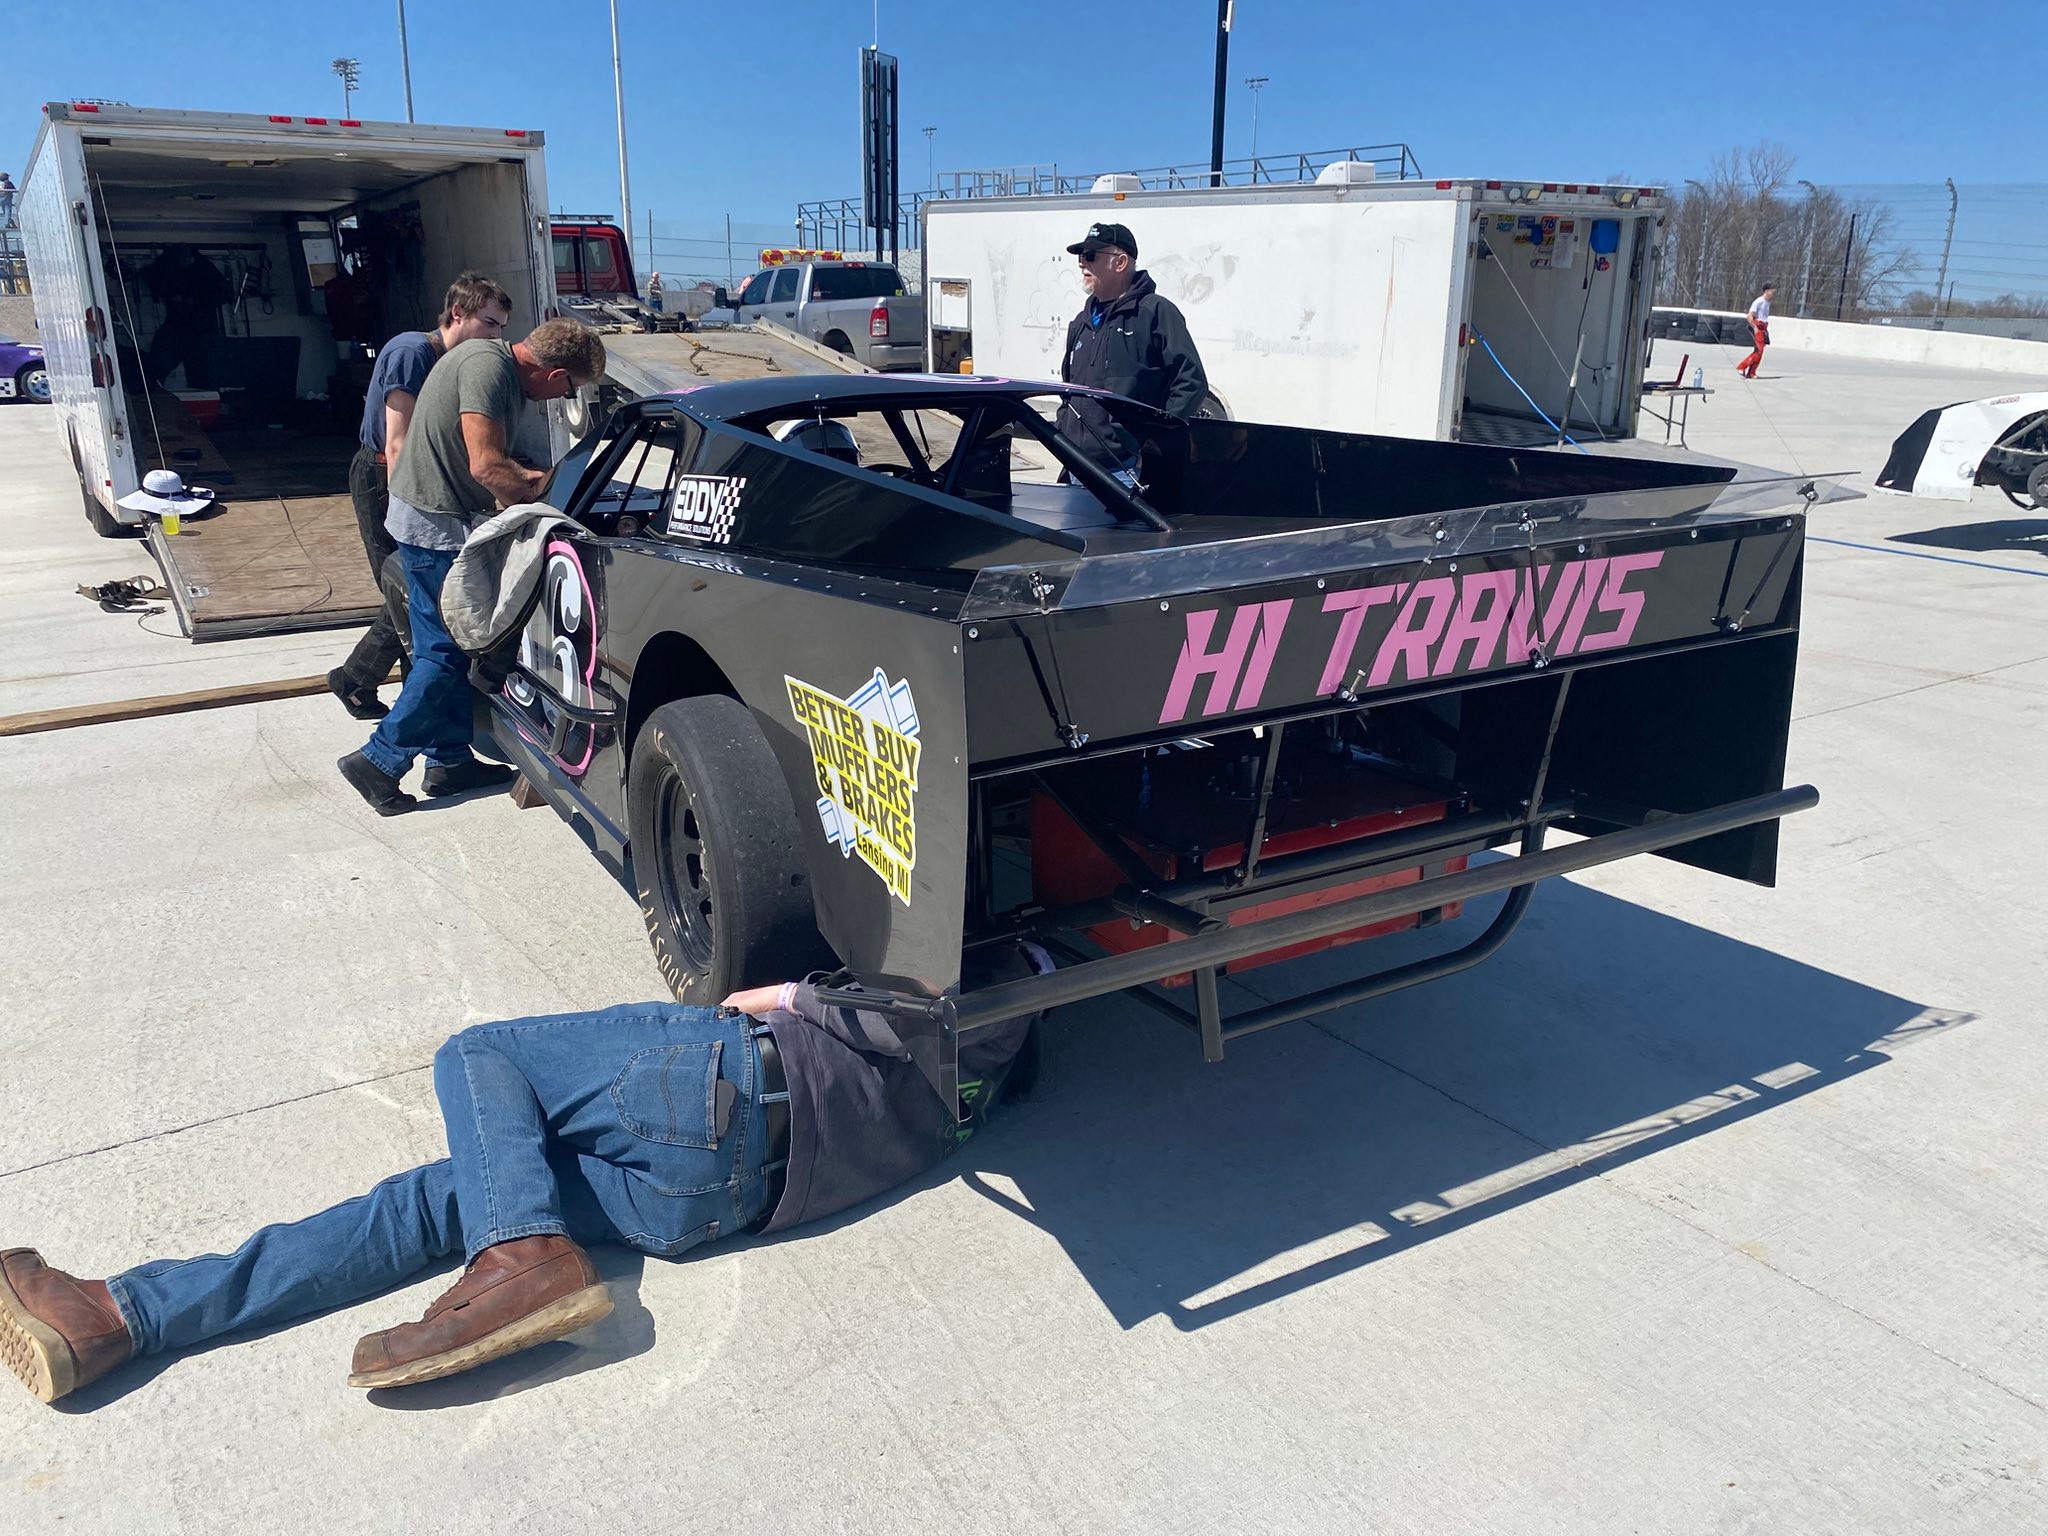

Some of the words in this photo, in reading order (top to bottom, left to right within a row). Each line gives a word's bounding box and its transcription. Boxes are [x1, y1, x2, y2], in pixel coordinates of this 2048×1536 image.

[674, 480, 725, 524] EDDY
[1158, 598, 1295, 724] HI
[1316, 551, 1665, 696] TRAVIS
[788, 683, 869, 753] BETTER
[872, 722, 917, 782] BUY
[809, 725, 911, 818] MUFFLERS
[817, 760, 835, 798] &
[839, 774, 914, 862] BRAKES
[855, 825, 895, 887] Lansing
[897, 863, 909, 898] MI
